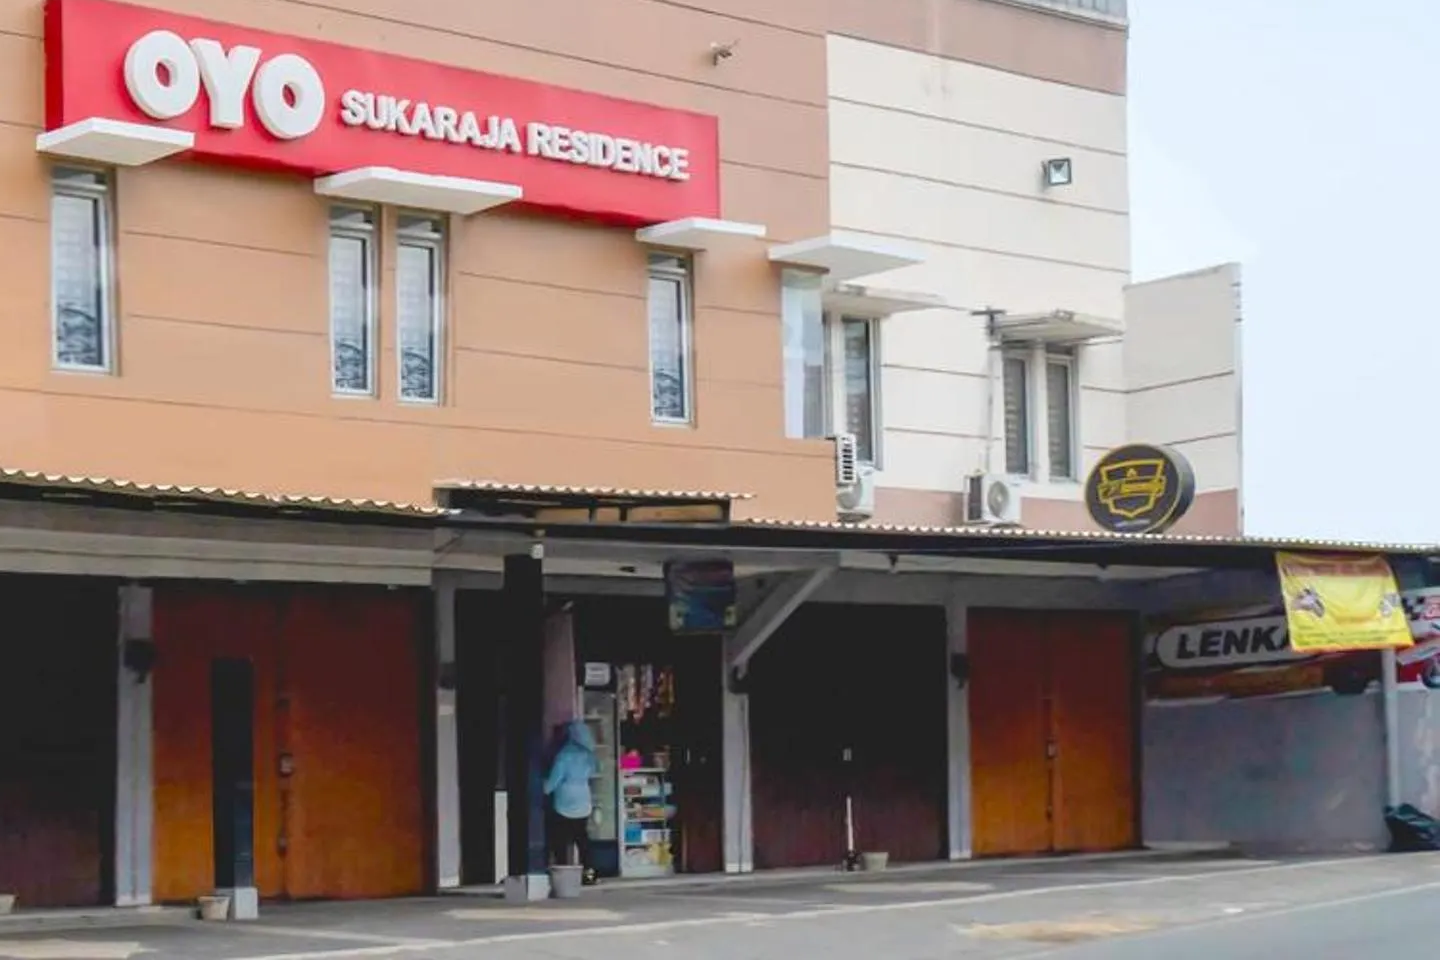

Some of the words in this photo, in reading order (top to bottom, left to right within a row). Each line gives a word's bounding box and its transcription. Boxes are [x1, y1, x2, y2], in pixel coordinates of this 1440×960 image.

[124, 30, 325, 139] OYO
[341, 90, 521, 153] SUKARAJA
[527, 122, 690, 180] RESIDENCE
